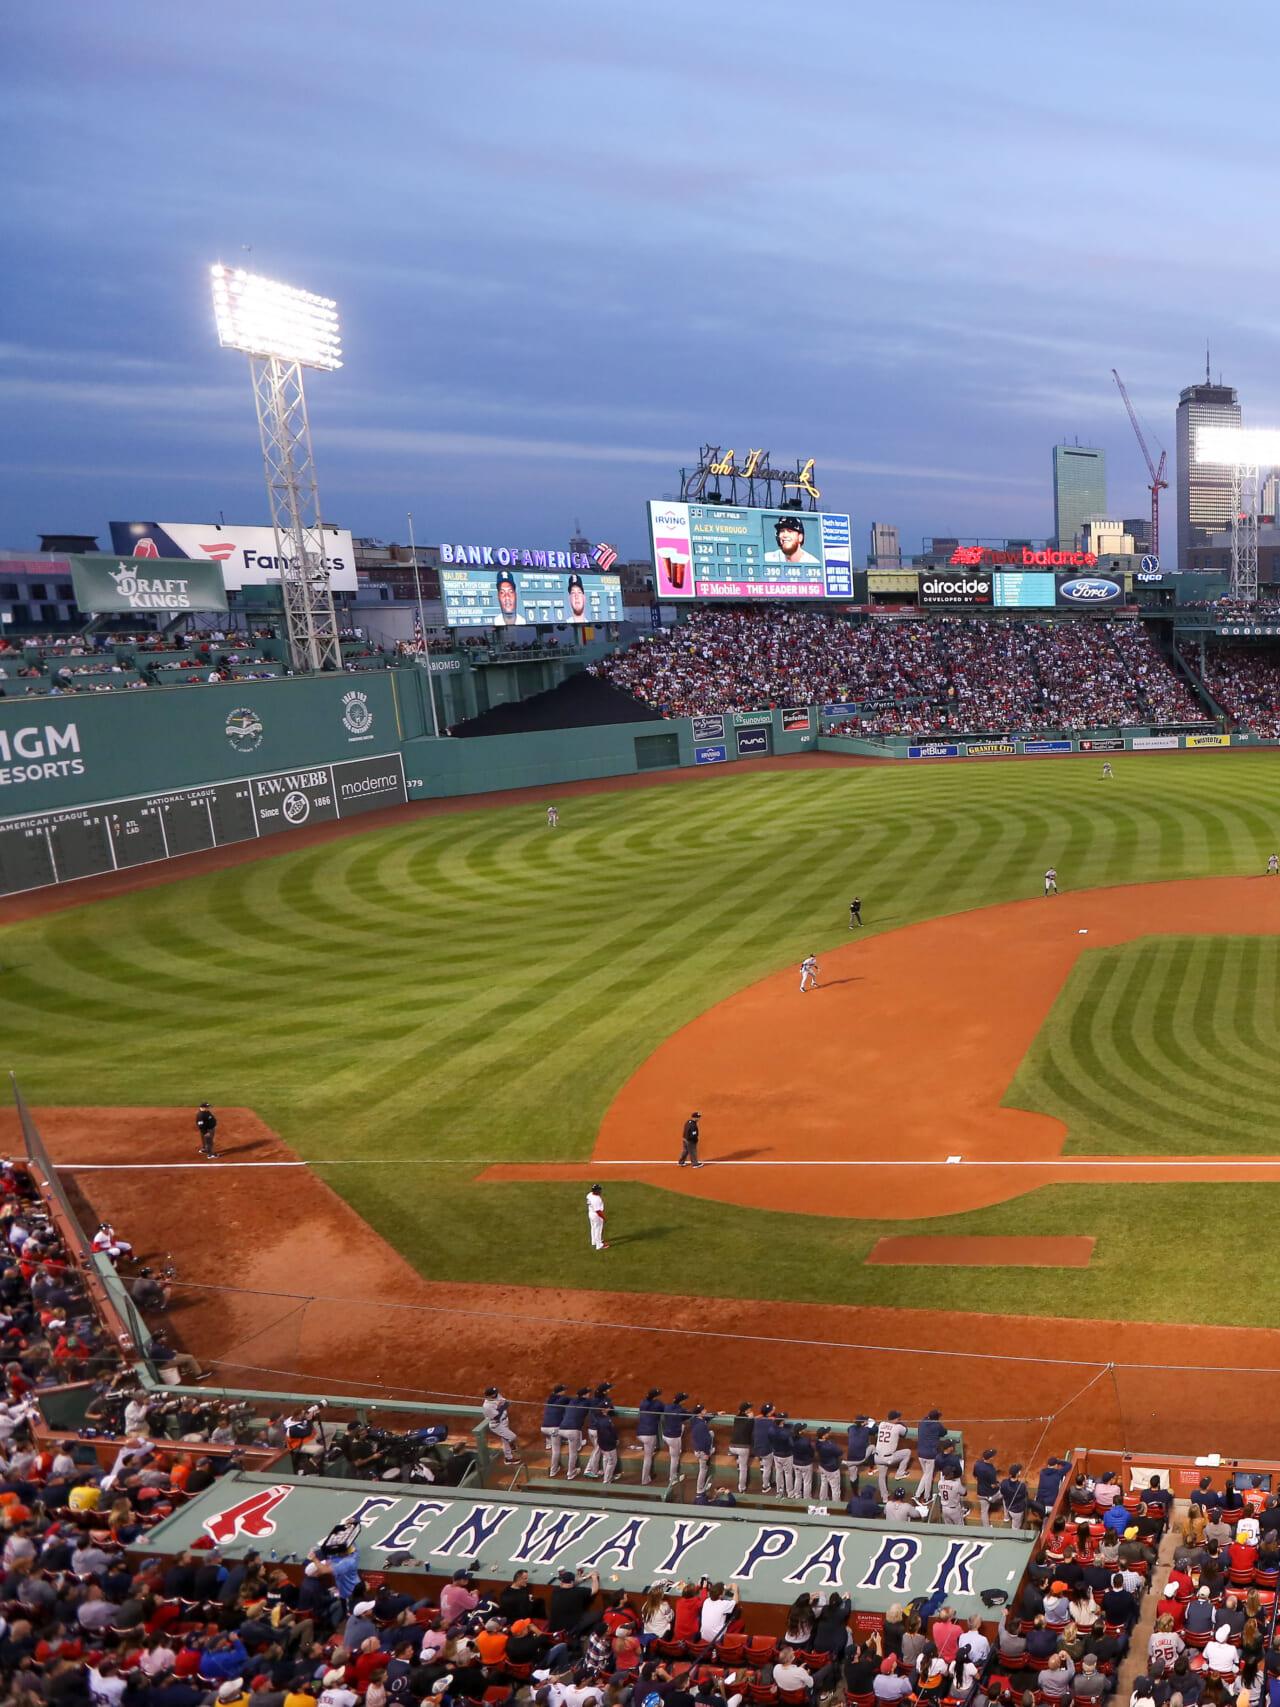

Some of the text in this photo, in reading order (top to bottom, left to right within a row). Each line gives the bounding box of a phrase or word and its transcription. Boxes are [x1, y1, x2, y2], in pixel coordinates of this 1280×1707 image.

[656, 516, 686, 526] IRVING
[694, 524, 748, 534] ALEX VERDUGO
[243, 550, 344, 571] Fancs
[440, 544, 590, 569] BANK OF AMERICA
[984, 546, 1098, 566] new balance
[1137, 573, 1162, 582] tyco
[117, 577, 188, 596] DRAFT
[710, 584, 741, 595] Mobile
[746, 585, 763, 594] THE
[765, 585, 798, 595] LEADER
[923, 579, 988, 594] airocide
[1072, 582, 1108, 599] Ford
[130, 594, 190, 608] KINGS
[528, 609, 535, 620] 0
[543, 609, 548, 621] 2
[557, 609, 563, 620] 0
[920, 745, 947, 755] jetBlue
[0, 759, 85, 784] ESORTS
[256, 771, 328, 797] F.W. WEBB
[341, 775, 398, 795] moderna
[407, 780, 423, 788] 379
[147, 789, 216, 806] NATIONAL LEAGUE
[314, 796, 331, 808] 1866
[260, 808, 279, 819] Since
[0, 811, 88, 832] AMERICAN LEAGUE
[879, 1431, 891, 1443] 22
[319, 1494, 995, 1597] FENWAY PARK
[1155, 1639, 1173, 1647] LOWELL
[1155, 1648, 1174, 1662] 25
